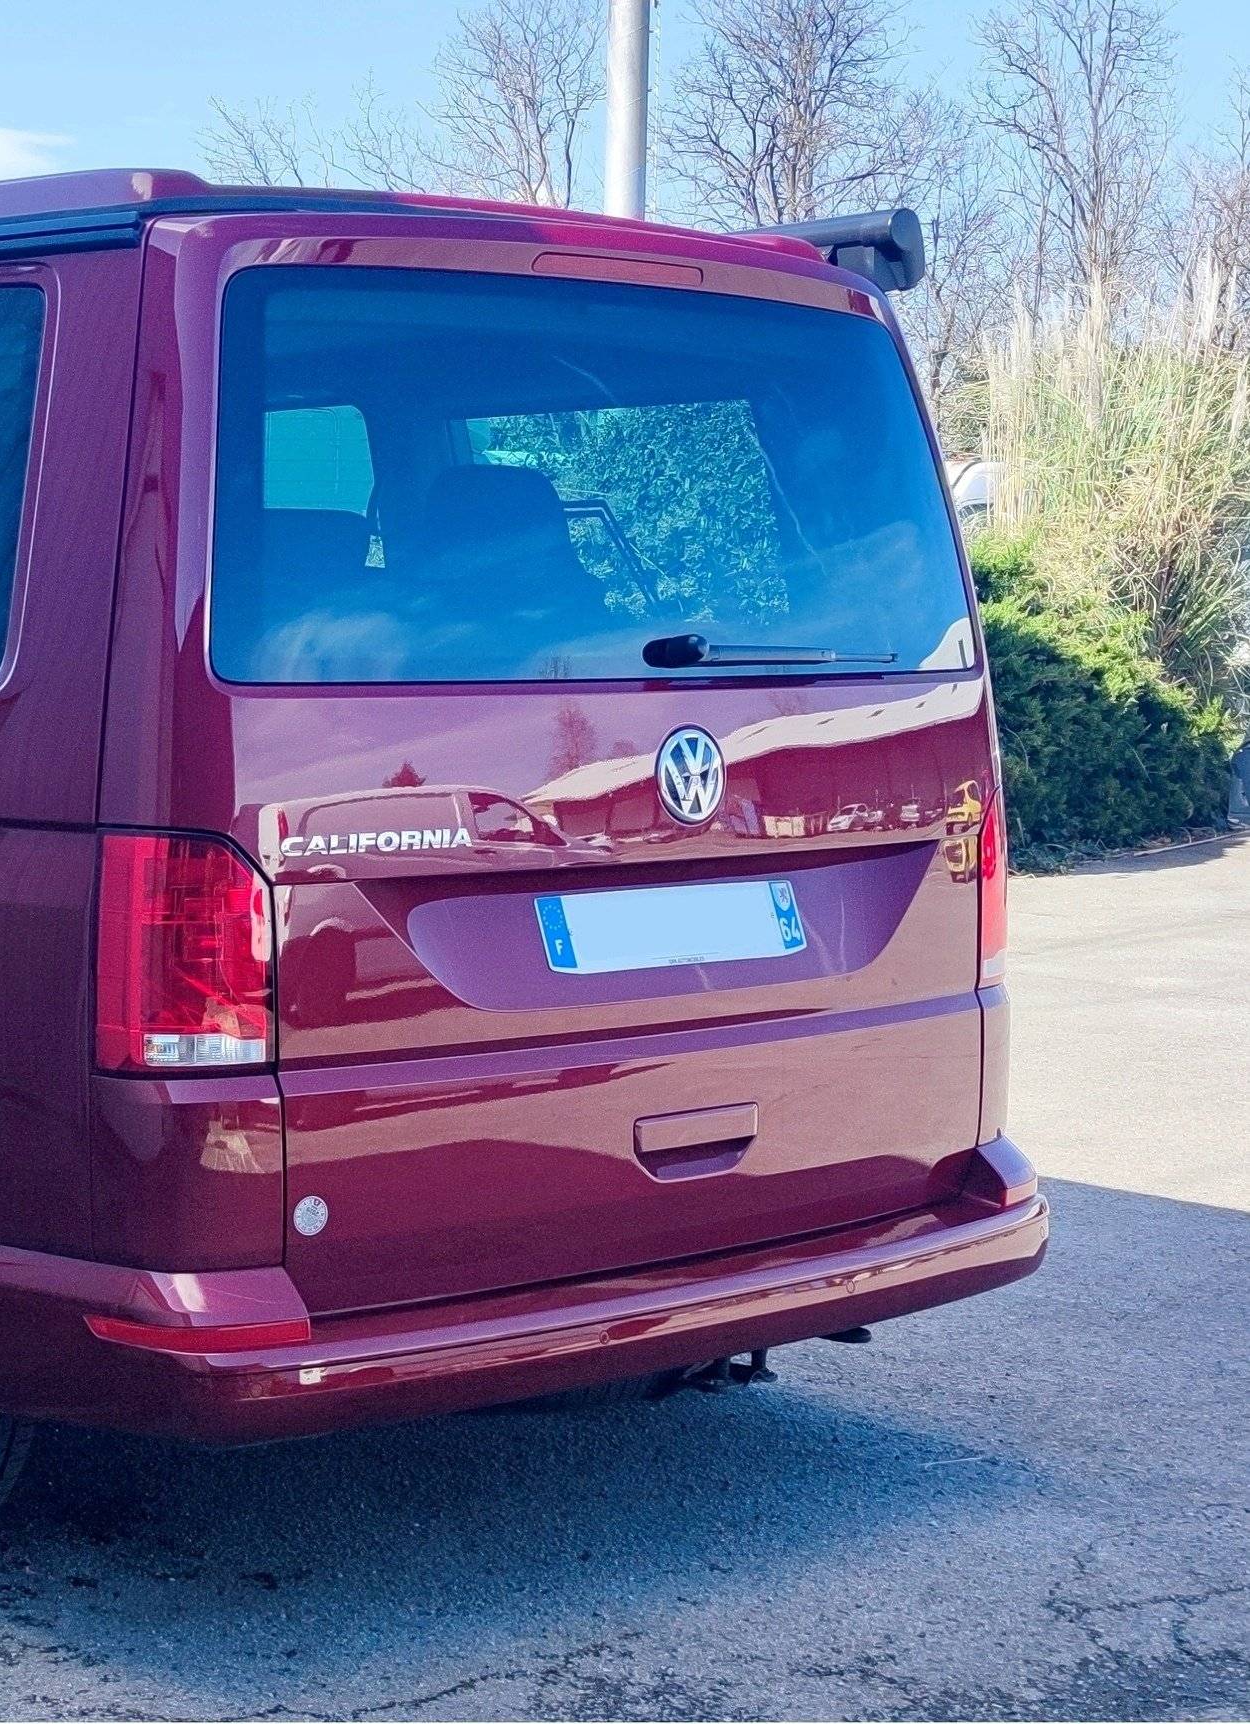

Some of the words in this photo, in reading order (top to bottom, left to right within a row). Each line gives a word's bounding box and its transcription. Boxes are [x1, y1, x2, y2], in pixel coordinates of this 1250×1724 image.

[280, 828, 472, 857] CALIFORNIA
[778, 917, 801, 942] 64
[555, 939, 563, 956] F
